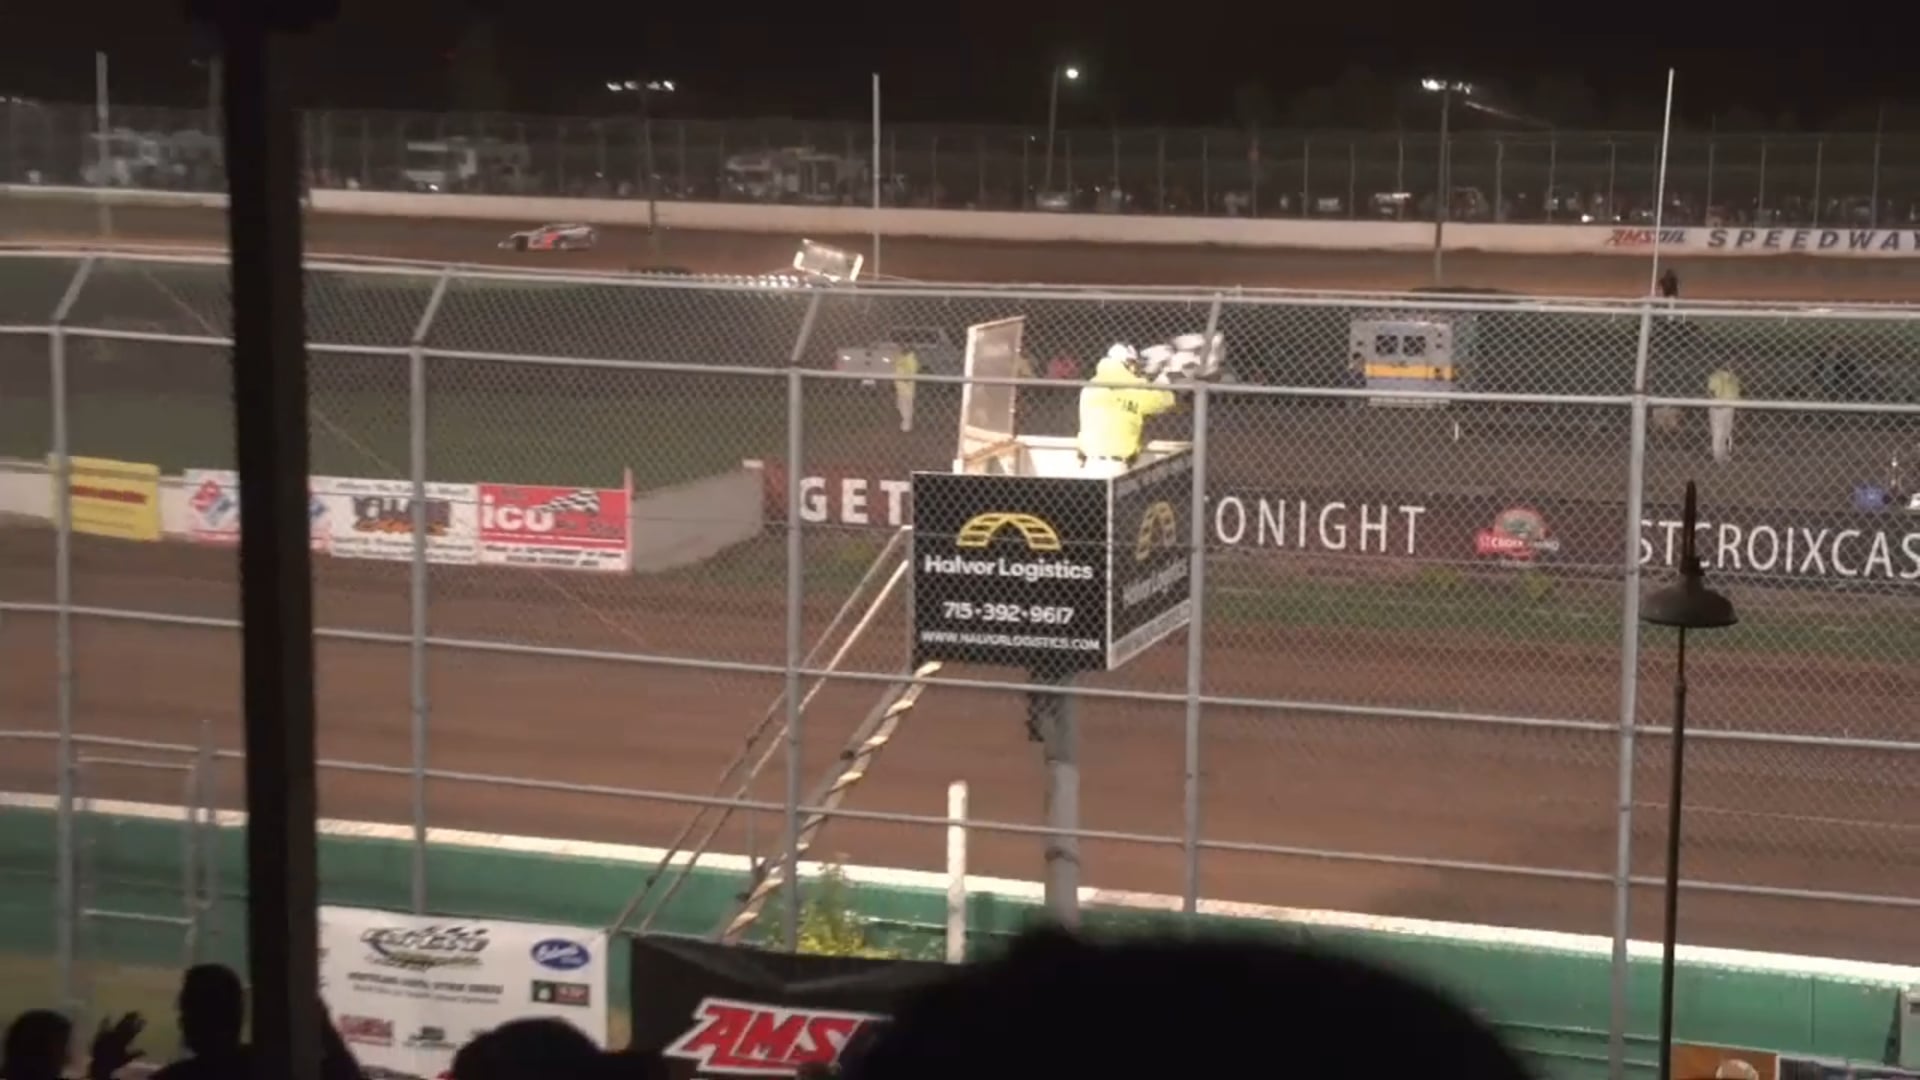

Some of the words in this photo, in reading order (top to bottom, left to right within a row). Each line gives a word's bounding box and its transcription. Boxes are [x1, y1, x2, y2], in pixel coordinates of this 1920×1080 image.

[1606, 227, 1687, 248] AMSOIL
[799, 476, 911, 526] GET
[1203, 495, 1427, 555] ONIGHT
[924, 555, 996, 575] Halvor
[999, 558, 1094, 582] Logistics
[664, 998, 864, 1075] AMS
